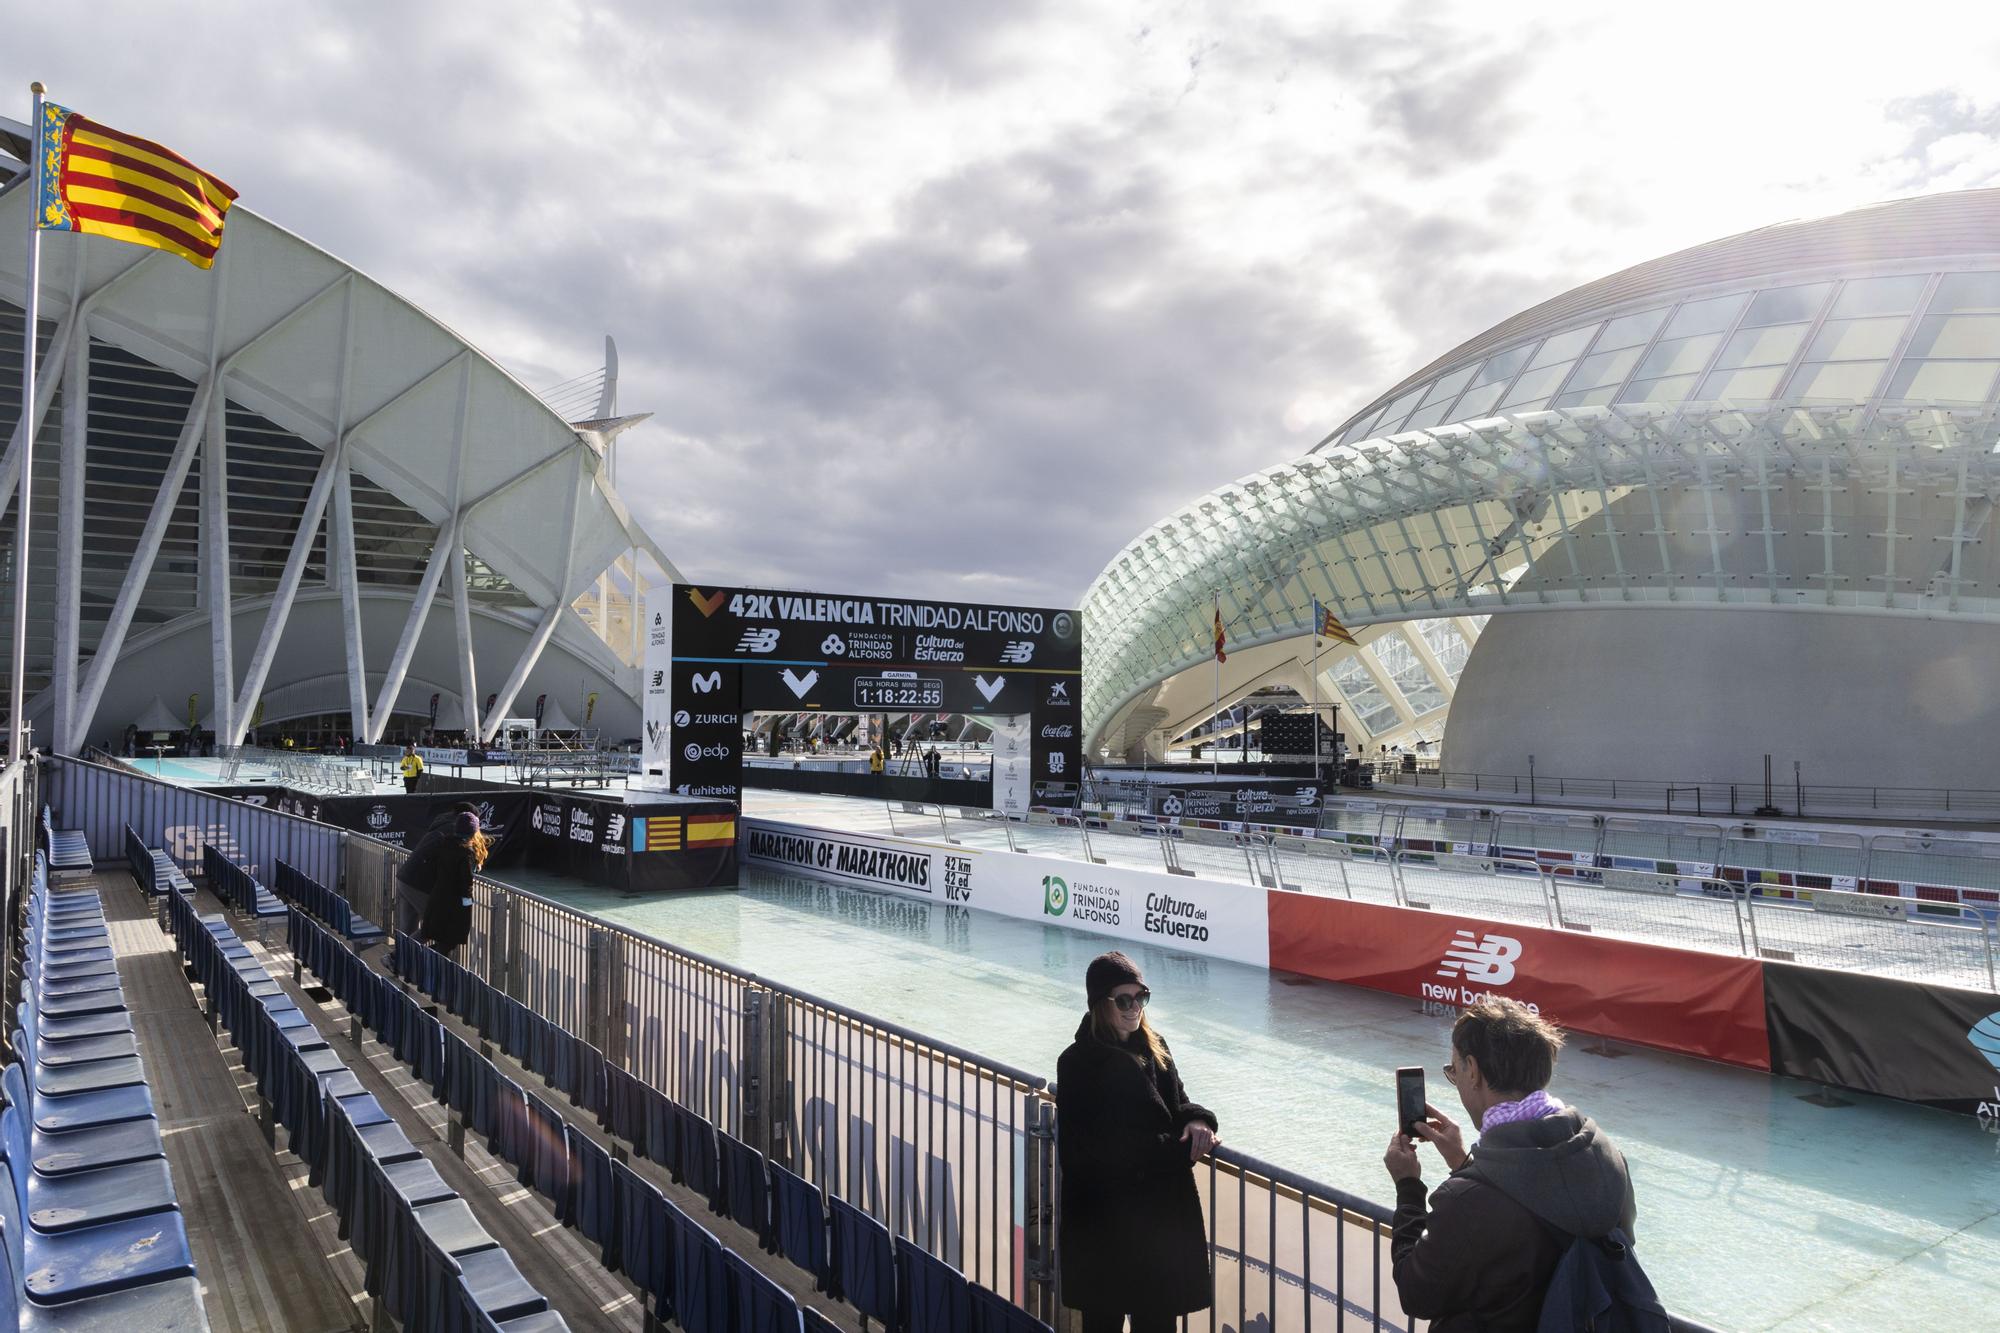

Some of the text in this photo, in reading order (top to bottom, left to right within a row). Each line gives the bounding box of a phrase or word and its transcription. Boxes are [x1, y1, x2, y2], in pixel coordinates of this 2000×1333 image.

[729, 594, 1044, 634] 42K VALENCIA TRINIDAD ALFONSO
[848, 632, 893, 640] FUNDACIÓN
[916, 634, 964, 650] Cultura del
[848, 640, 893, 650] TRINIDAD
[848, 650, 893, 660] ALFONSO
[914, 648, 964, 662] Esfuerzo
[860, 689, 940, 704] 1:18:22:55
[695, 714, 738, 724] ZURICH
[703, 743, 730, 761] edp
[691, 784, 737, 796] whitebit
[1236, 789, 1268, 801] Cultura
[1186, 807, 1220, 816] ALFONSO
[570, 823, 594, 844] Esfuerzo
[750, 831, 929, 886] MARATHON OF MARATHONS
[945, 856, 971, 873] 42 km
[945, 872, 969, 888] 42 ed
[945, 885, 960, 900] VLC
[1073, 882, 1120, 896] FUNDACIÓN
[1072, 893, 1120, 912] TRINIDAD
[1146, 892, 1208, 921] Cultura del
[1073, 907, 1120, 926] ALFONSO
[1145, 912, 1209, 942] Esfuerzo
[1421, 982, 1457, 1002] new
